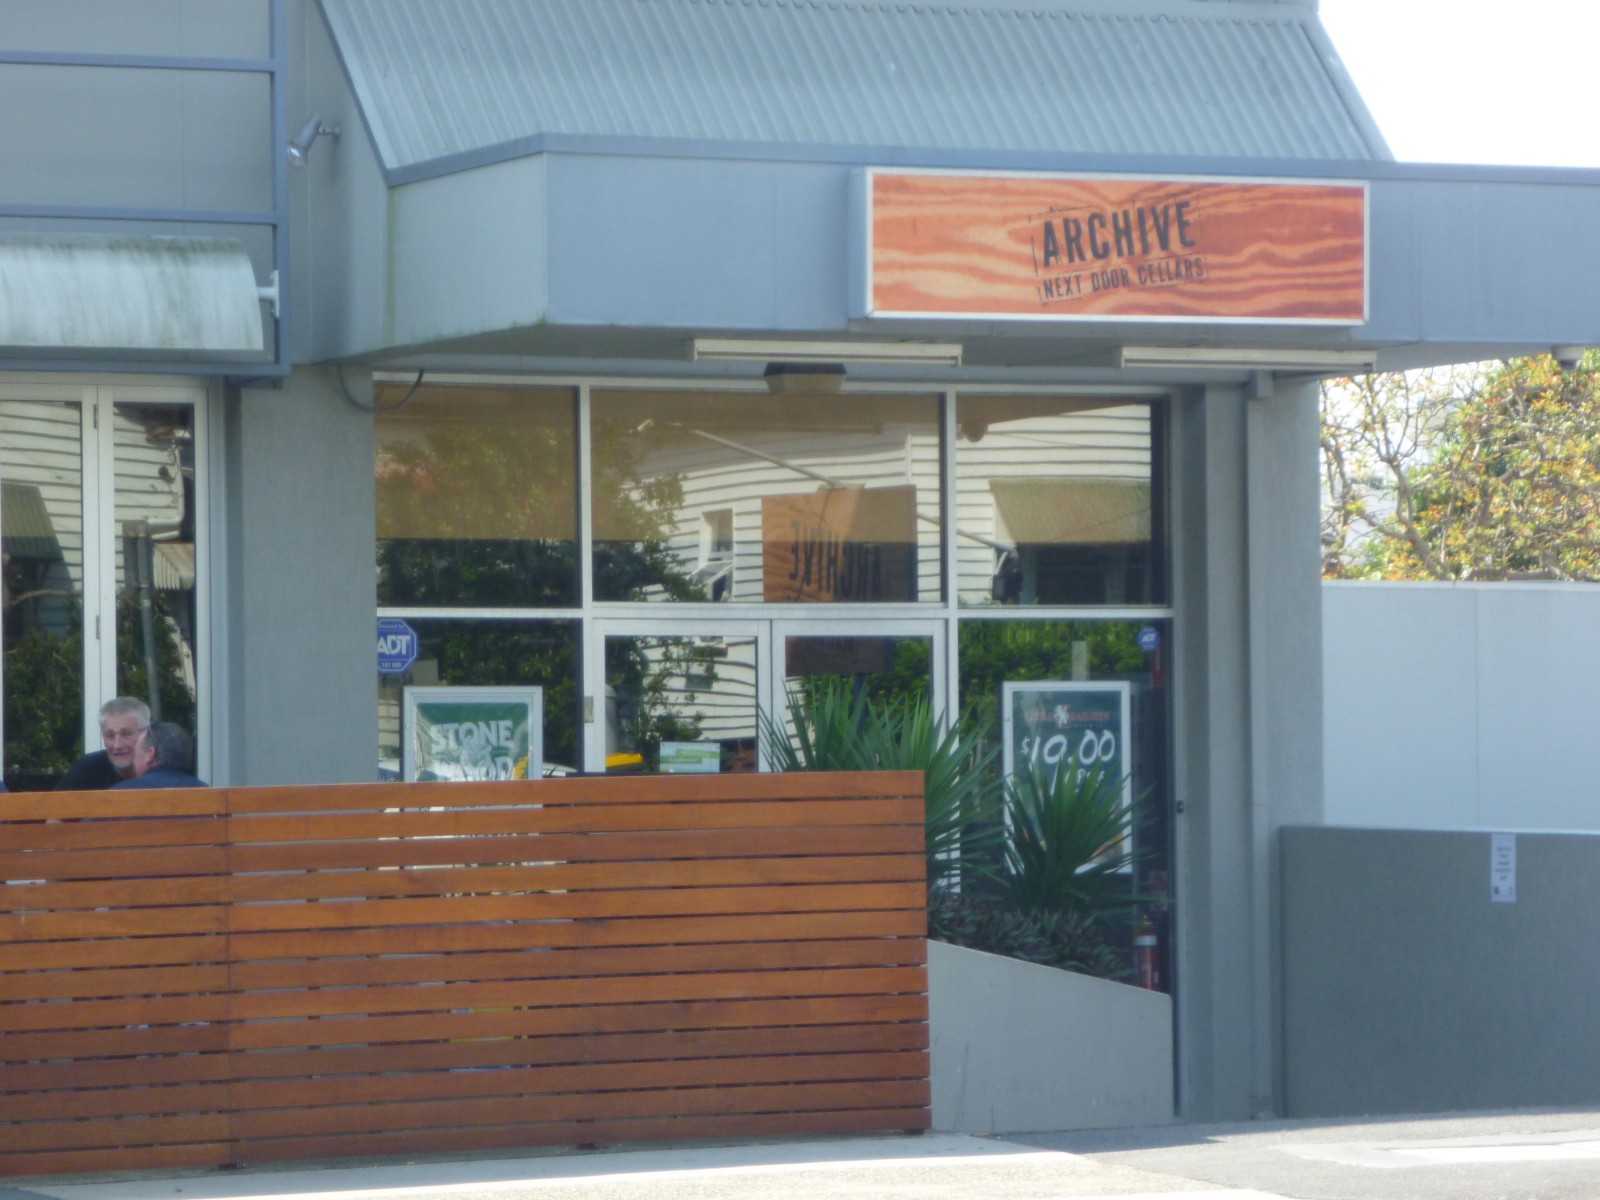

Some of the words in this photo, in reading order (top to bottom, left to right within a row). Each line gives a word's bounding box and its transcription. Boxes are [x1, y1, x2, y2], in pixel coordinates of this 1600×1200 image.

[1043, 201, 1196, 268] ARCHIVE
[1042, 274, 1082, 298] NEXT
[1091, 268, 1130, 292] DOOR
[1137, 257, 1204, 285] CELLARS
[377, 635, 410, 655] ADT
[430, 720, 513, 754] STONE
